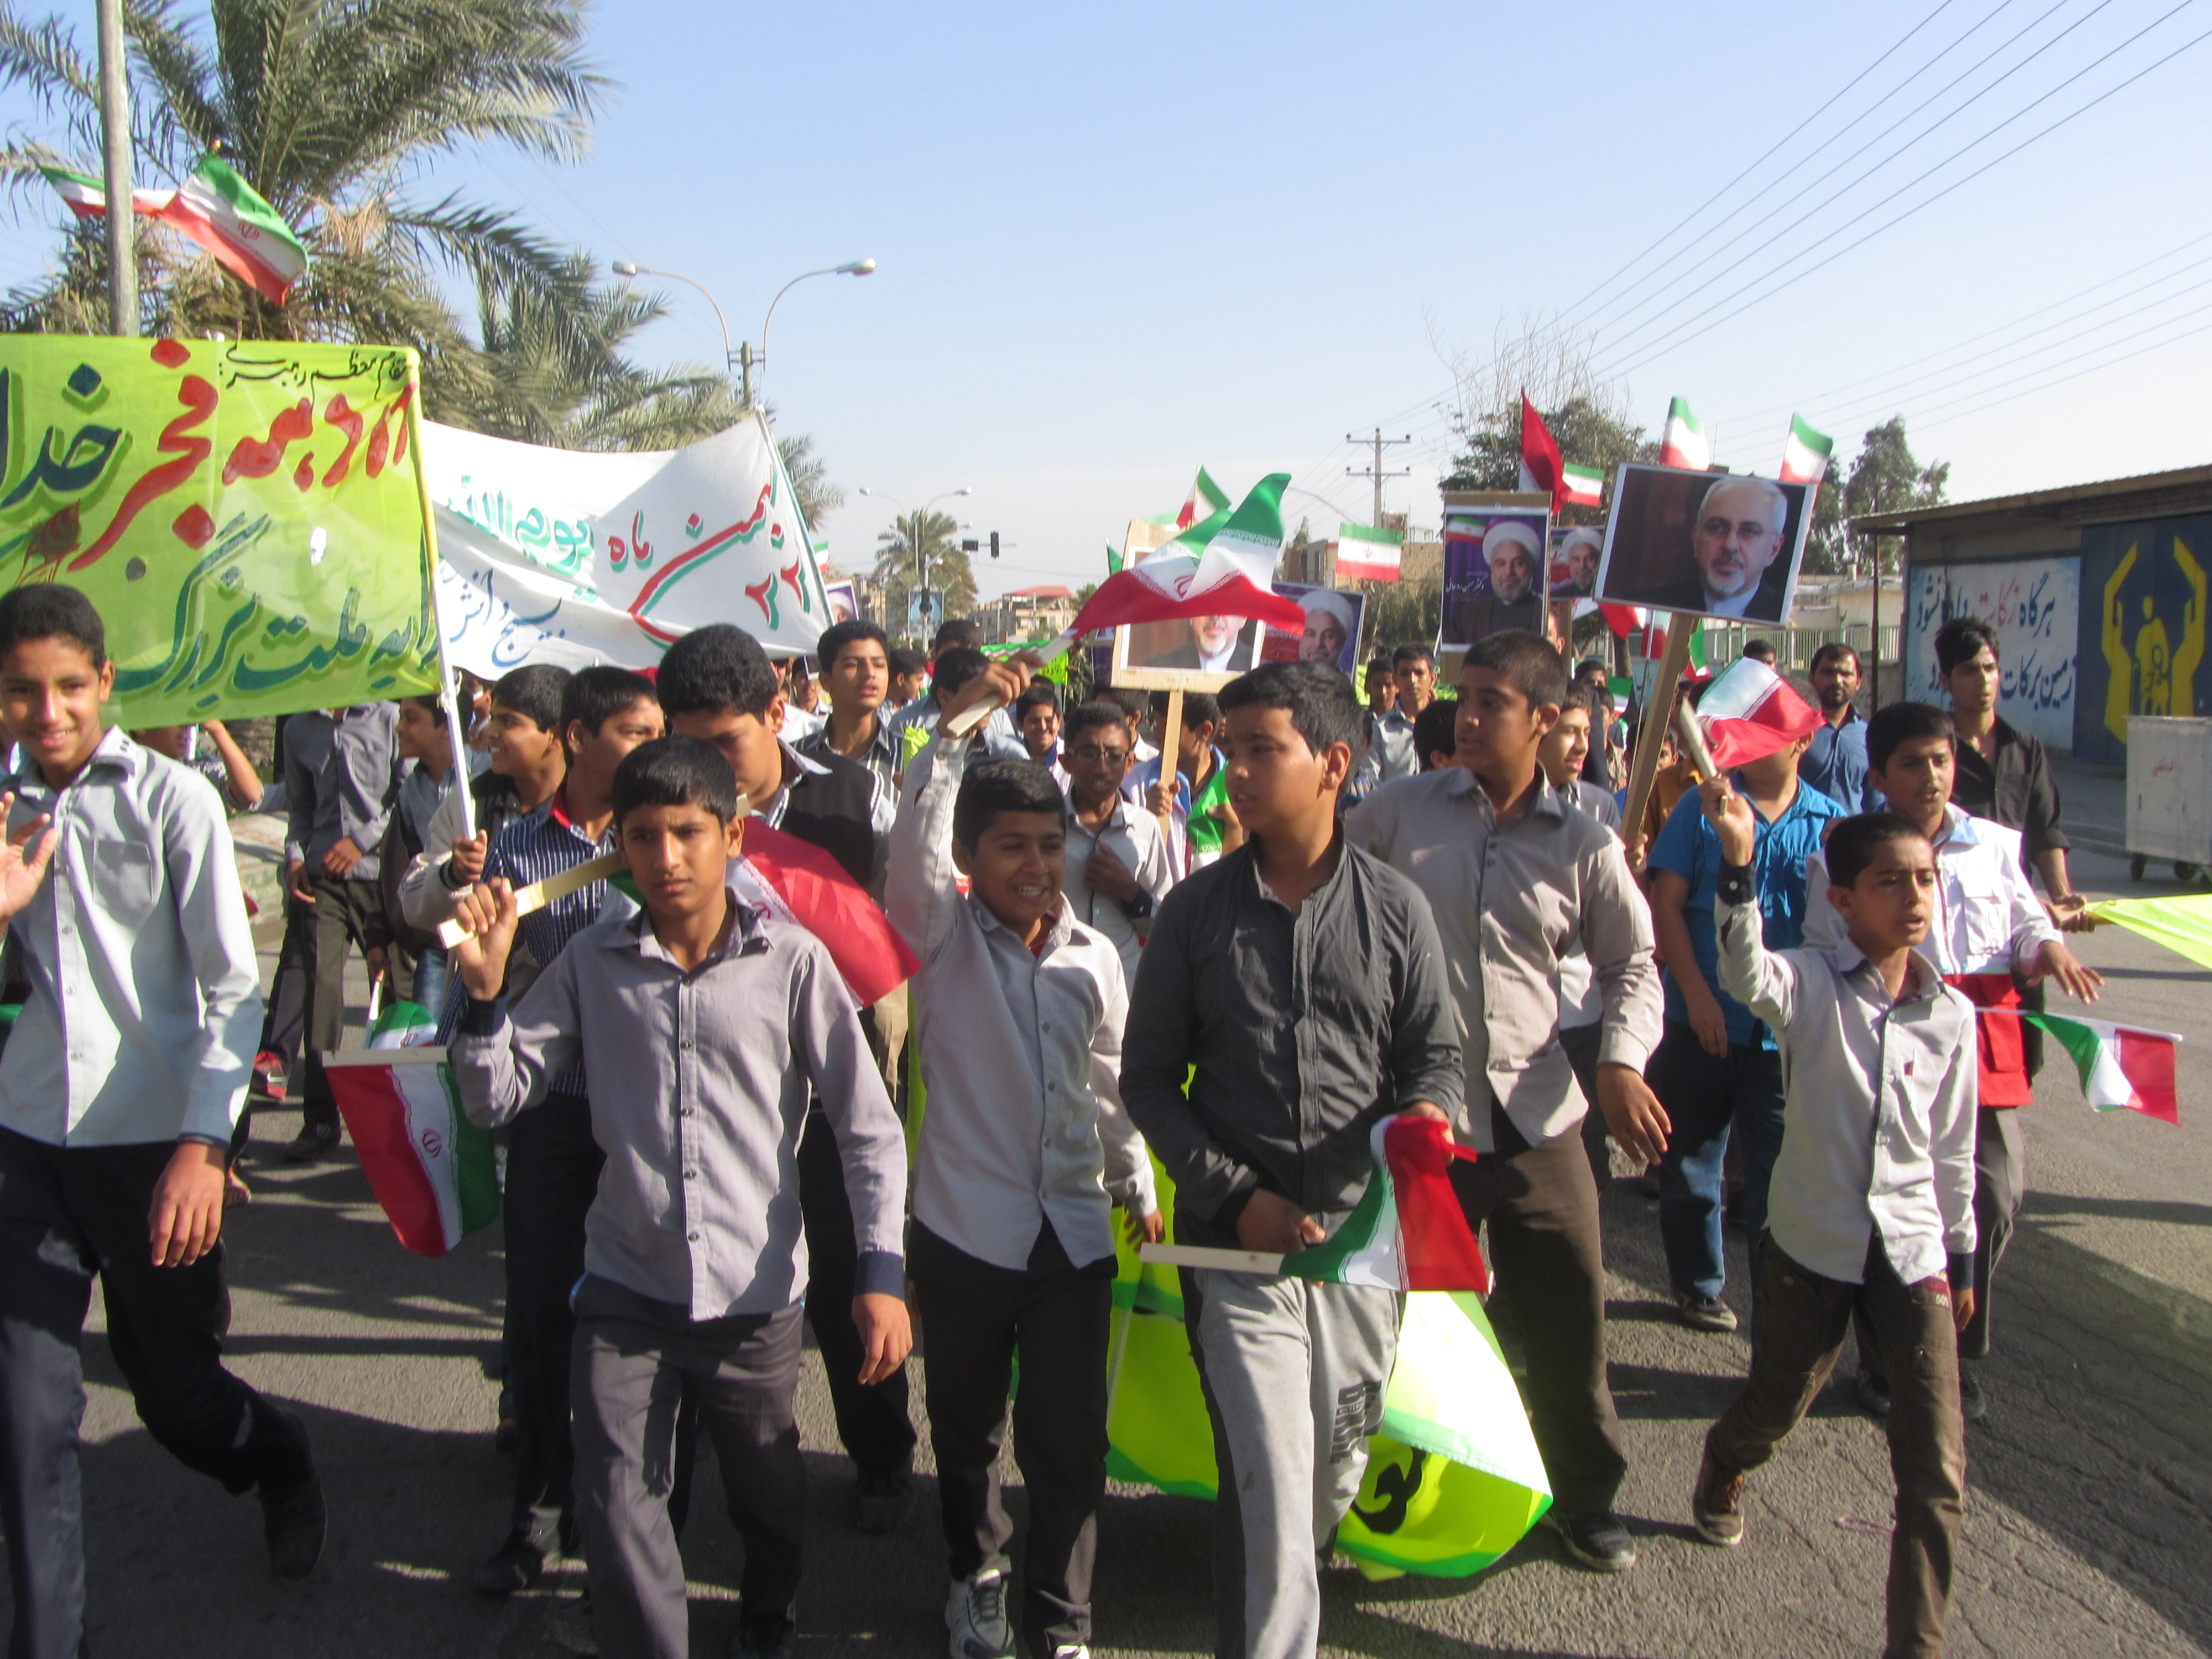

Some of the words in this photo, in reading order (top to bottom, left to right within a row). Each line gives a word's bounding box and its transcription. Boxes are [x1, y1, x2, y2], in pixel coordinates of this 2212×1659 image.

[66, 338, 219, 573] فجر
[112, 512, 269, 710] بزرگ
[608, 509, 654, 573] ماه
[628, 463, 784, 651] بهمن
[2019, 571, 2056, 639] هرگاه
[232, 586, 367, 691] ملت
